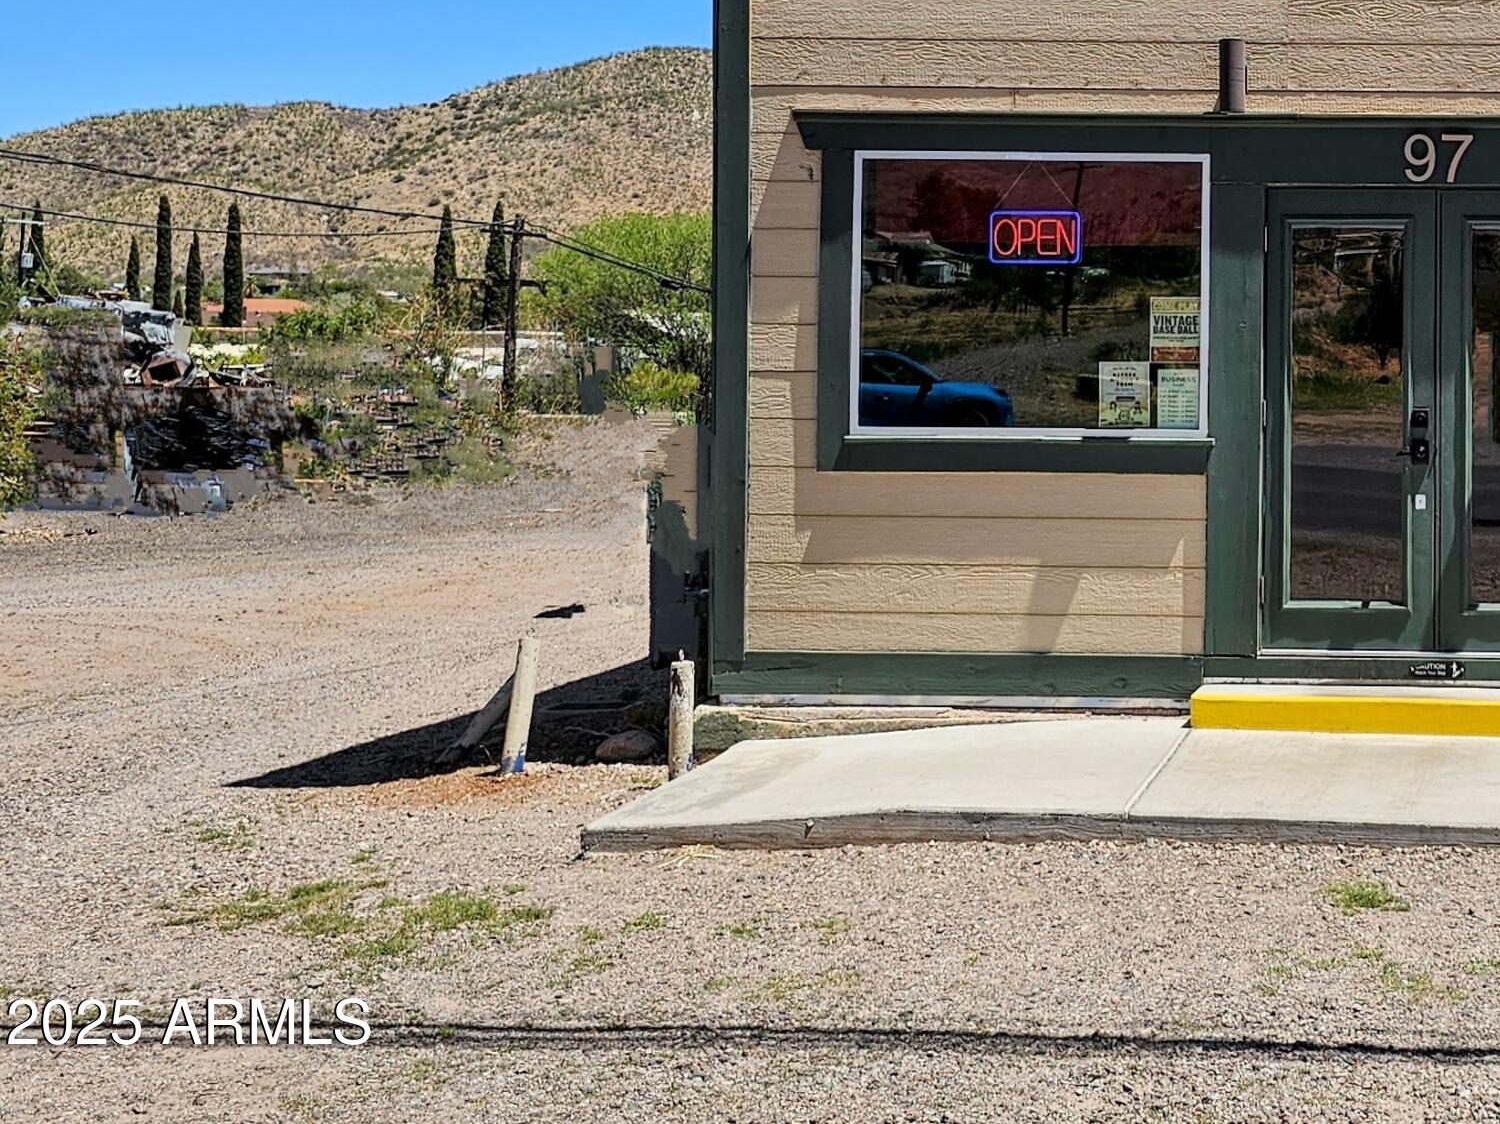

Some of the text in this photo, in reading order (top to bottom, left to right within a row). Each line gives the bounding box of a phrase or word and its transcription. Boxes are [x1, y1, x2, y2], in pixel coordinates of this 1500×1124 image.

[1404, 133, 1473, 183] 97
[994, 219, 1076, 255] OPEN
[1153, 315, 1199, 326] VINTAGE
[1153, 326, 1199, 334] BASE BALL
